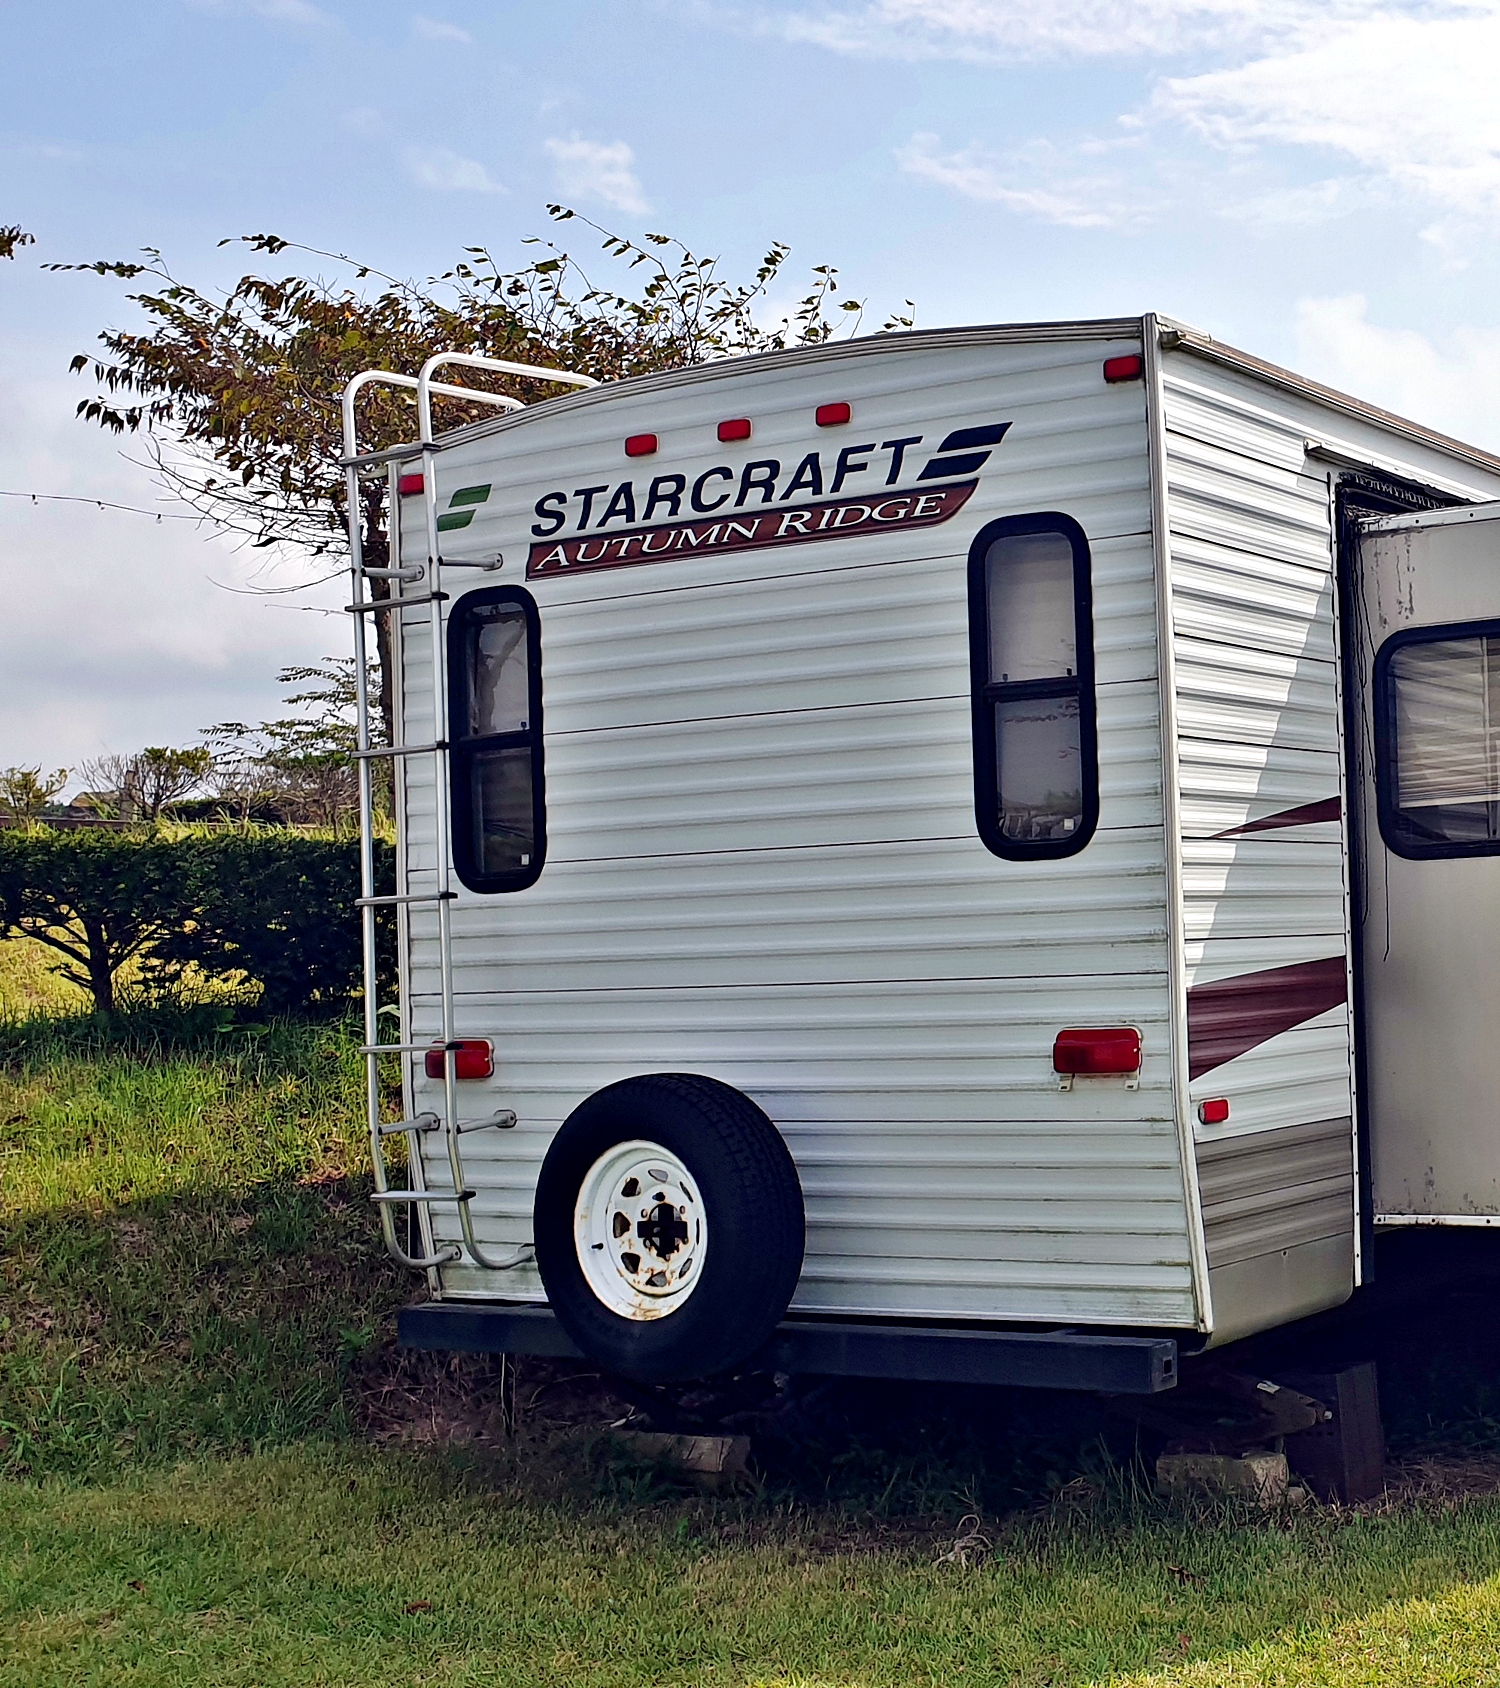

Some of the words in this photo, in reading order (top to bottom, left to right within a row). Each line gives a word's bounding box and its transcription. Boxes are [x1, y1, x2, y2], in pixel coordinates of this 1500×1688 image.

[531, 436, 923, 537] STARCRAFT
[535, 518, 762, 570] AUTUMN
[778, 493, 947, 537] RIDGE
